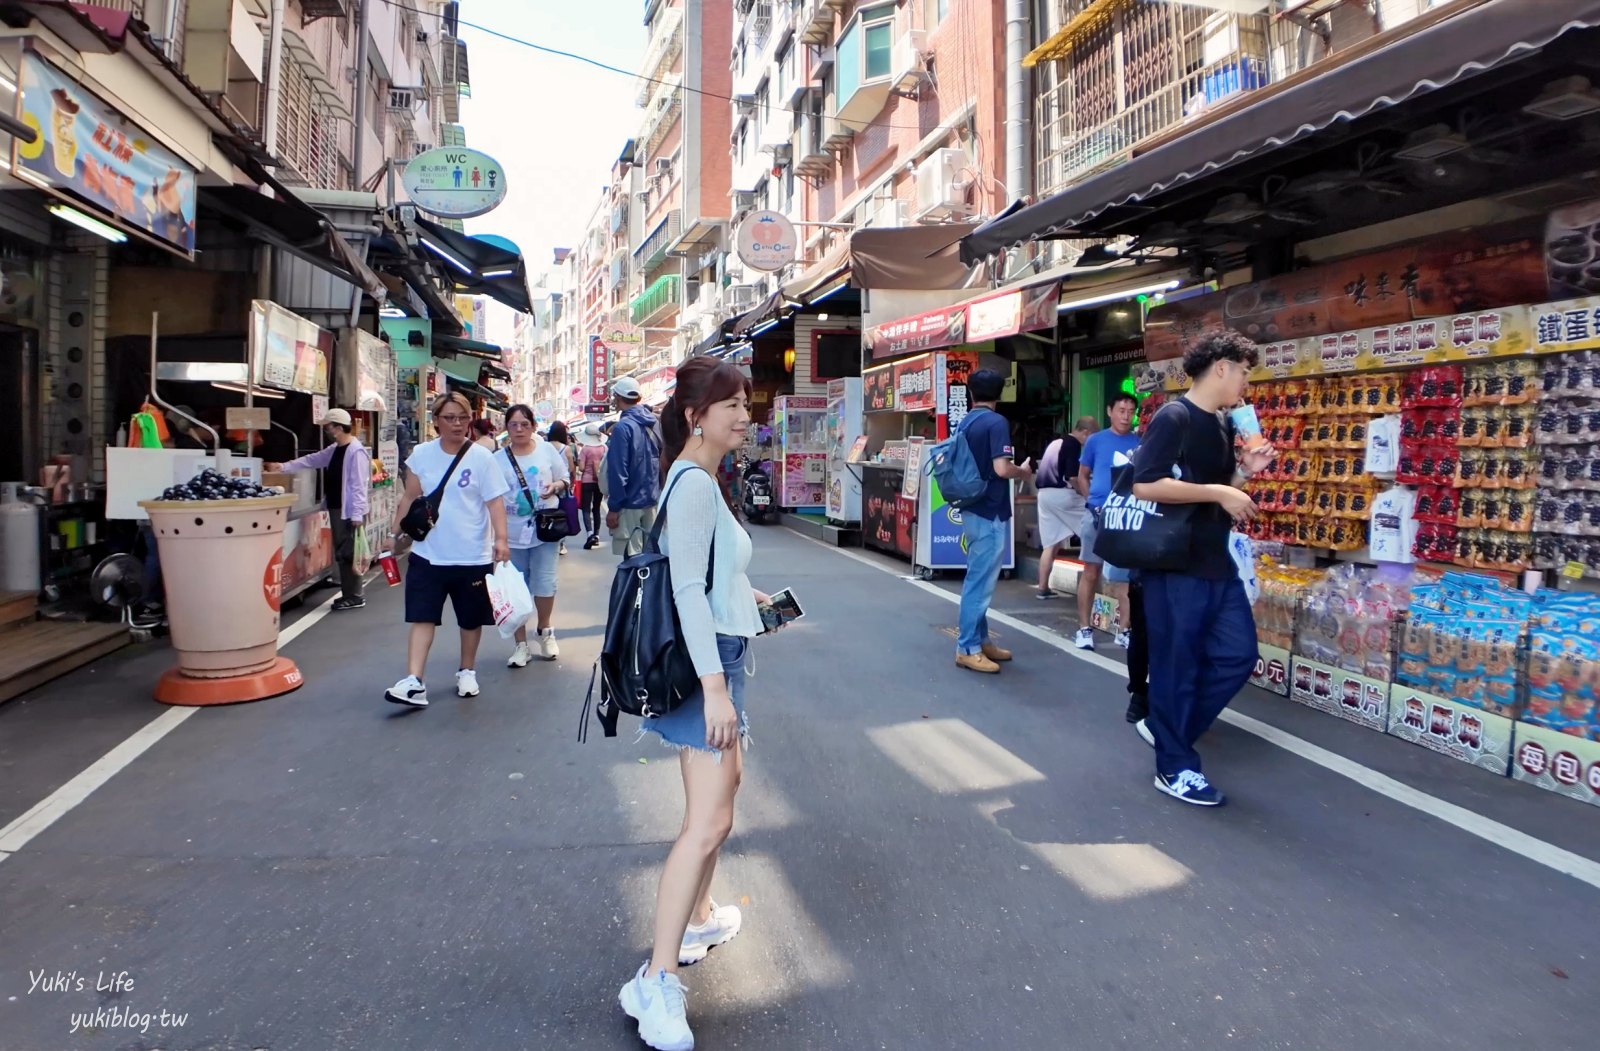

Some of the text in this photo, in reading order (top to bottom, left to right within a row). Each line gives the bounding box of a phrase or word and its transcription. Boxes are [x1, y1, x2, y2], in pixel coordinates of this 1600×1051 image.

[445, 154, 467, 163] WC
[1372, 322, 1436, 354] 黑胡椒
[1085, 354, 1112, 366] Taiwan
[457, 468, 471, 488] 8
[1104, 507, 1145, 531] TOKYO
[1254, 659, 1283, 682] 0元
